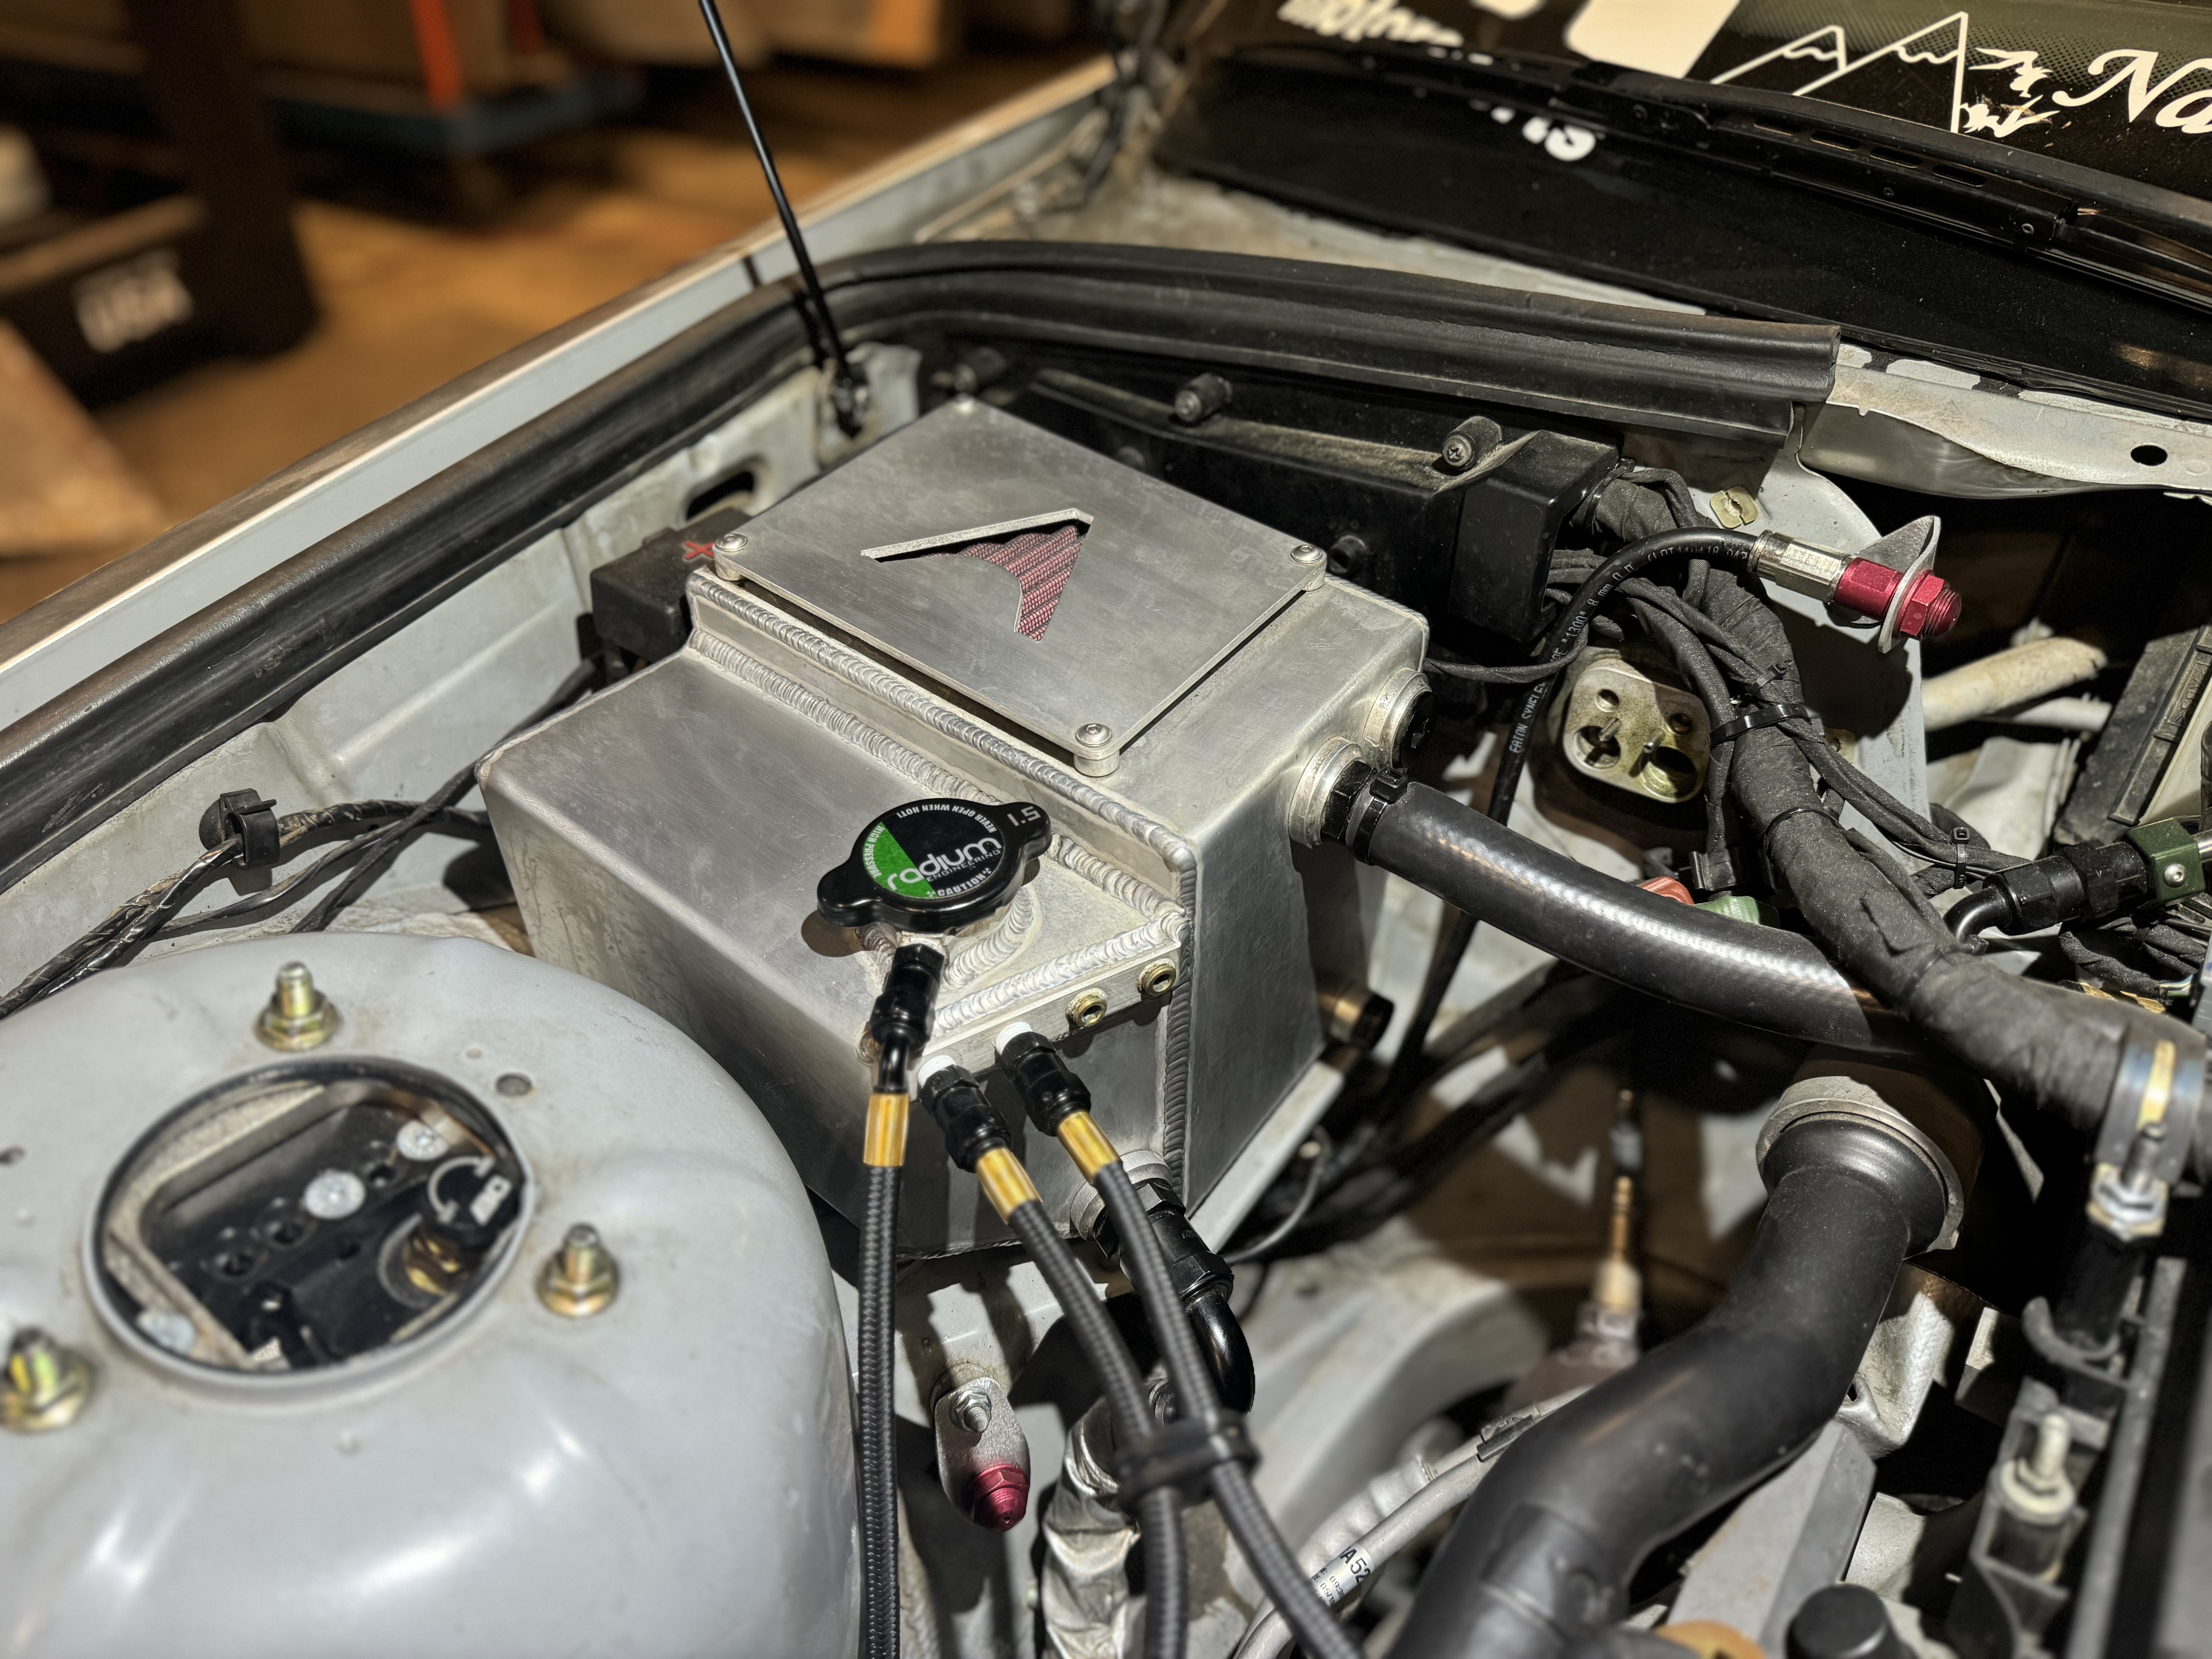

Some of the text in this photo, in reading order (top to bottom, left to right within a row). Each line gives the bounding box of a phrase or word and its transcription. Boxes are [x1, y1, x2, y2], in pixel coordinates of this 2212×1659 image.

[952, 805, 975, 817] OPEN
[1007, 806, 1041, 826] 1.5
[974, 814, 997, 833] NEVER
[864, 826, 885, 879] HIGH PRESSURE
[887, 838, 1002, 890] radium
[926, 849, 1001, 882] ENGINEERING
[937, 873, 986, 896] CAUTION
